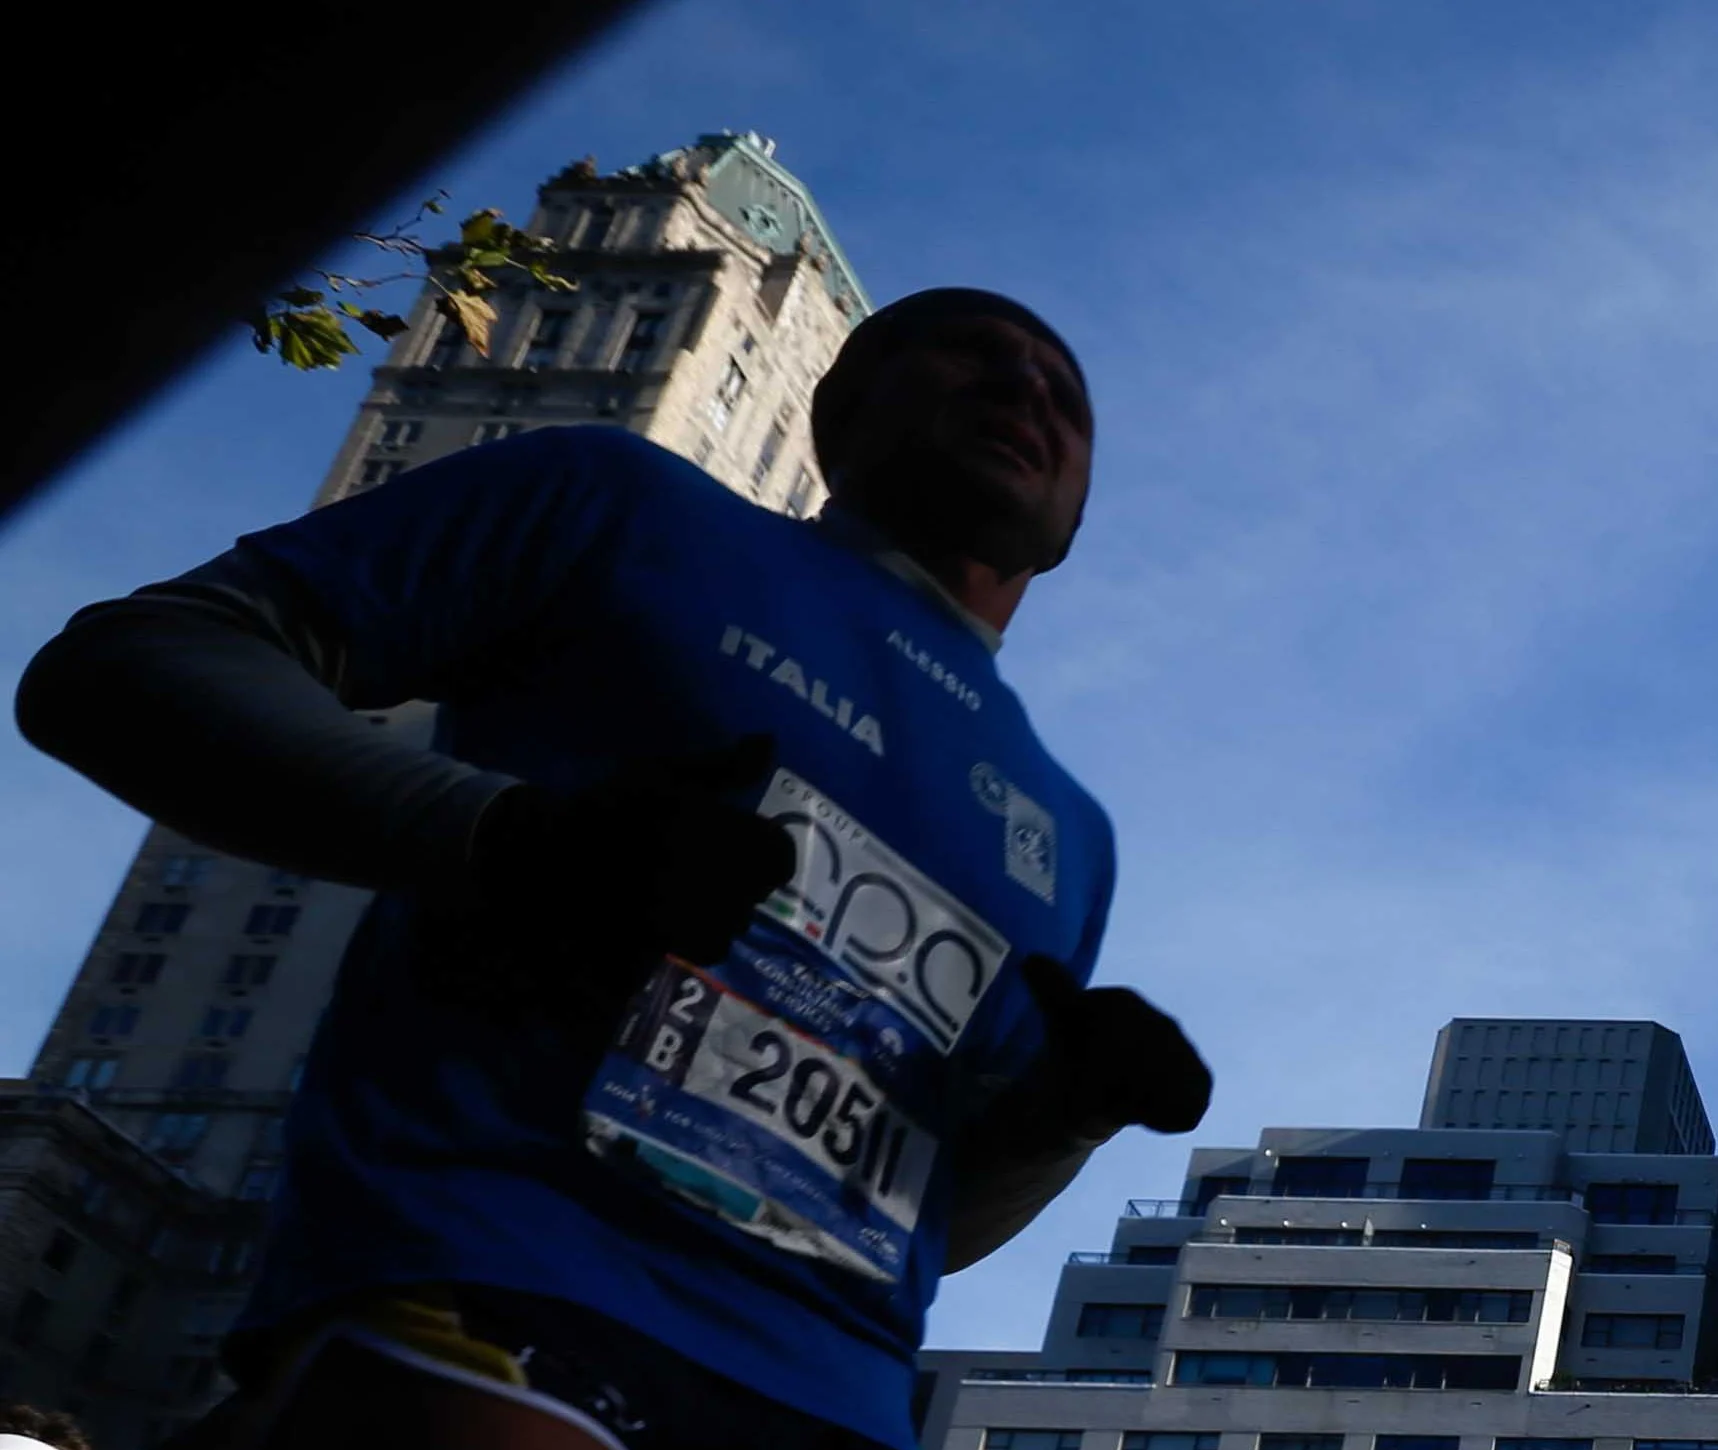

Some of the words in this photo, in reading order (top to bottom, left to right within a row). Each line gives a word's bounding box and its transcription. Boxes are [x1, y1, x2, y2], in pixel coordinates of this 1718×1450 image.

[718, 624, 886, 758] ITALIA
[668, 976, 706, 1026] 2
[645, 1024, 684, 1073] B
[728, 1030, 906, 1198] 20511
